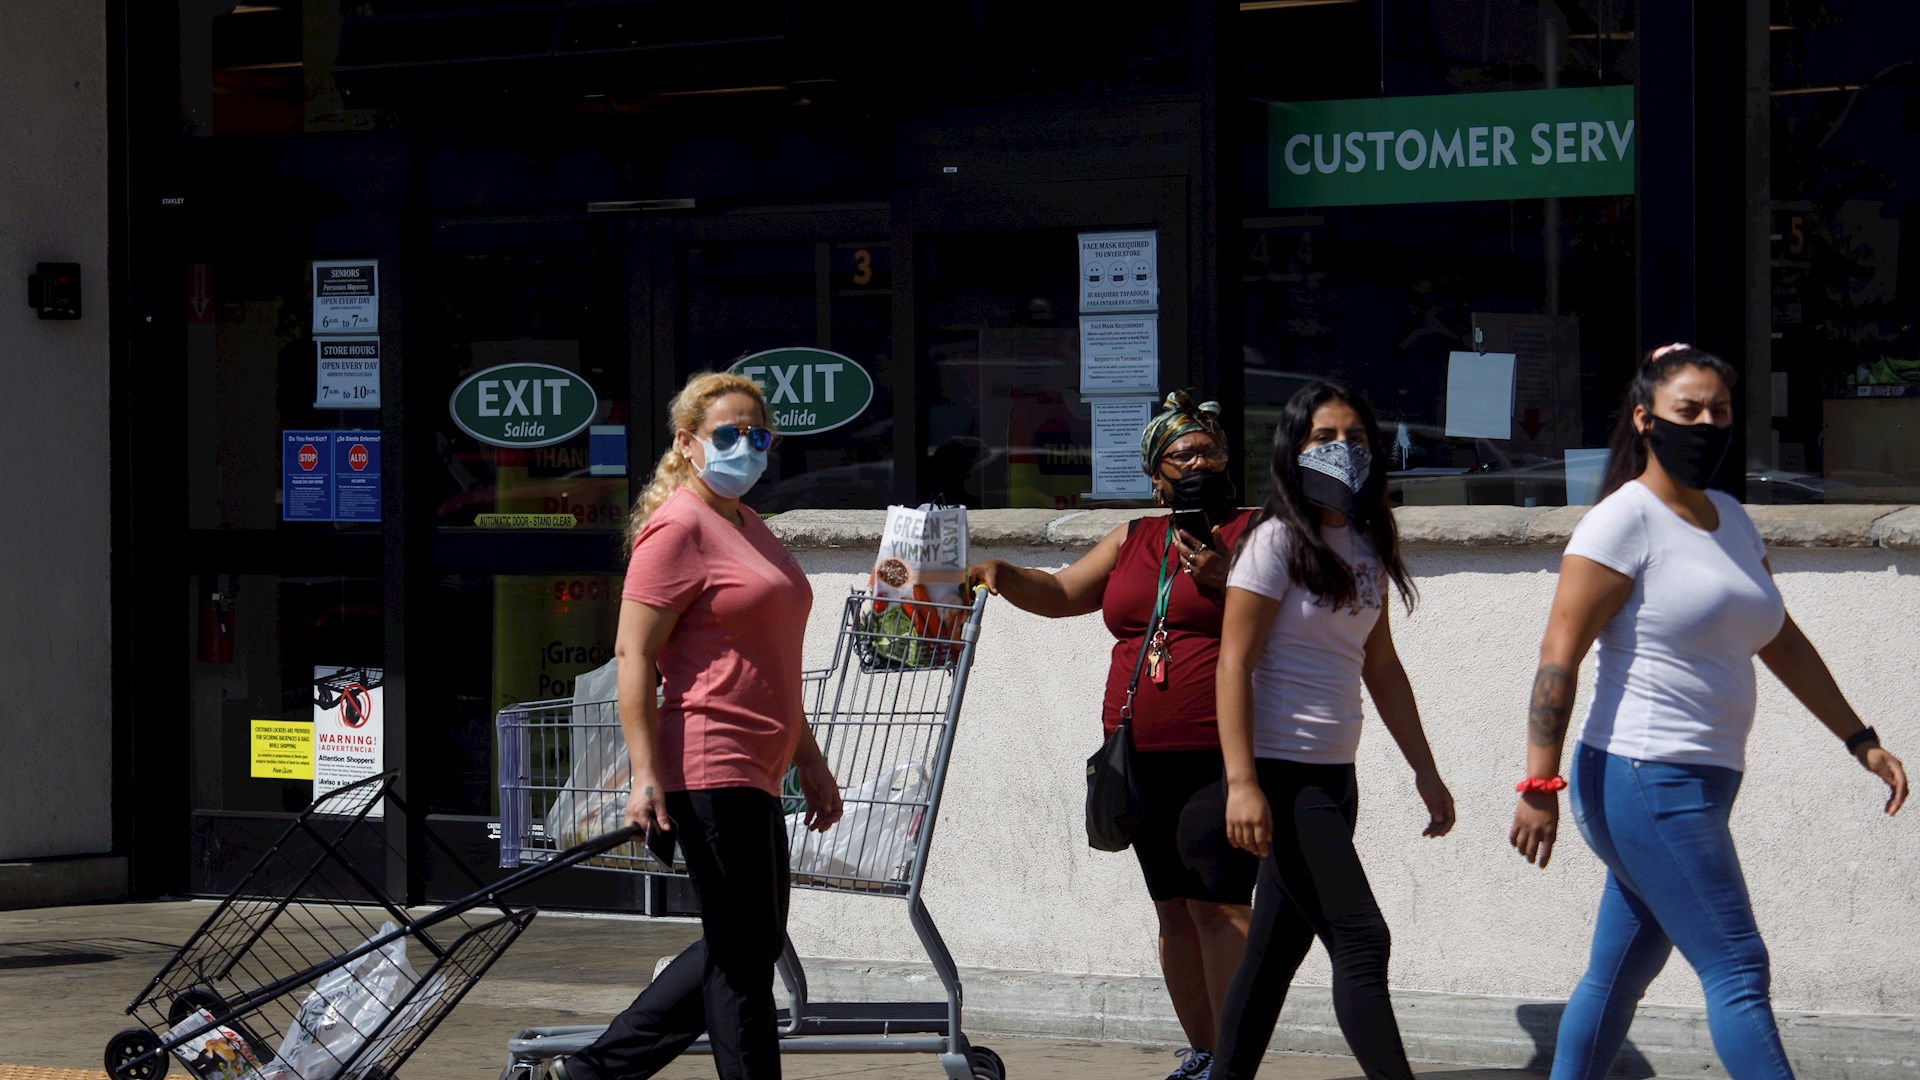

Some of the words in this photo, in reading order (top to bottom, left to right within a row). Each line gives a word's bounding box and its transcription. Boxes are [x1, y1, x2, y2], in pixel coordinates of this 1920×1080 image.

[1284, 126, 1517, 175] CUSTOMER
[1531, 120, 1635, 166] SERV
[1789, 215, 1804, 256] 5
[1083, 242, 1098, 250] FACE
[1099, 241, 1117, 250] MASK
[1118, 240, 1149, 249] REQUIRED
[852, 248, 873, 286] 3
[331, 269, 360, 278] SENIORS
[338, 297, 358, 305] EVERY
[343, 320, 350, 328] to
[324, 346, 349, 356] STORE
[349, 345, 376, 355] HOURS
[322, 361, 340, 370] OPEN
[342, 361, 363, 370] EVERY
[364, 361, 378, 370] DAY
[343, 391, 350, 399] to
[478, 379, 570, 417] EXIT
[772, 409, 817, 429] Salida
[504, 421, 546, 438] Salida
[300, 453, 316, 462] STOP
[351, 453, 367, 462] ALTO
[533, 447, 589, 469] THAN
[480, 516, 512, 526] AUTOMATIC
[513, 516, 529, 526] DOOR
[534, 516, 551, 526] STAND
[553, 516, 571, 526] CLEAR
[894, 514, 941, 541] GREEN
[942, 512, 959, 568] TASTY
[891, 540, 941, 563] YUMMY
[319, 734, 377, 745] WARNING!
[319, 754, 345, 762] Attention
[346, 756, 375, 764] Shoppers!
[318, 778, 336, 786] ¡Aviso
